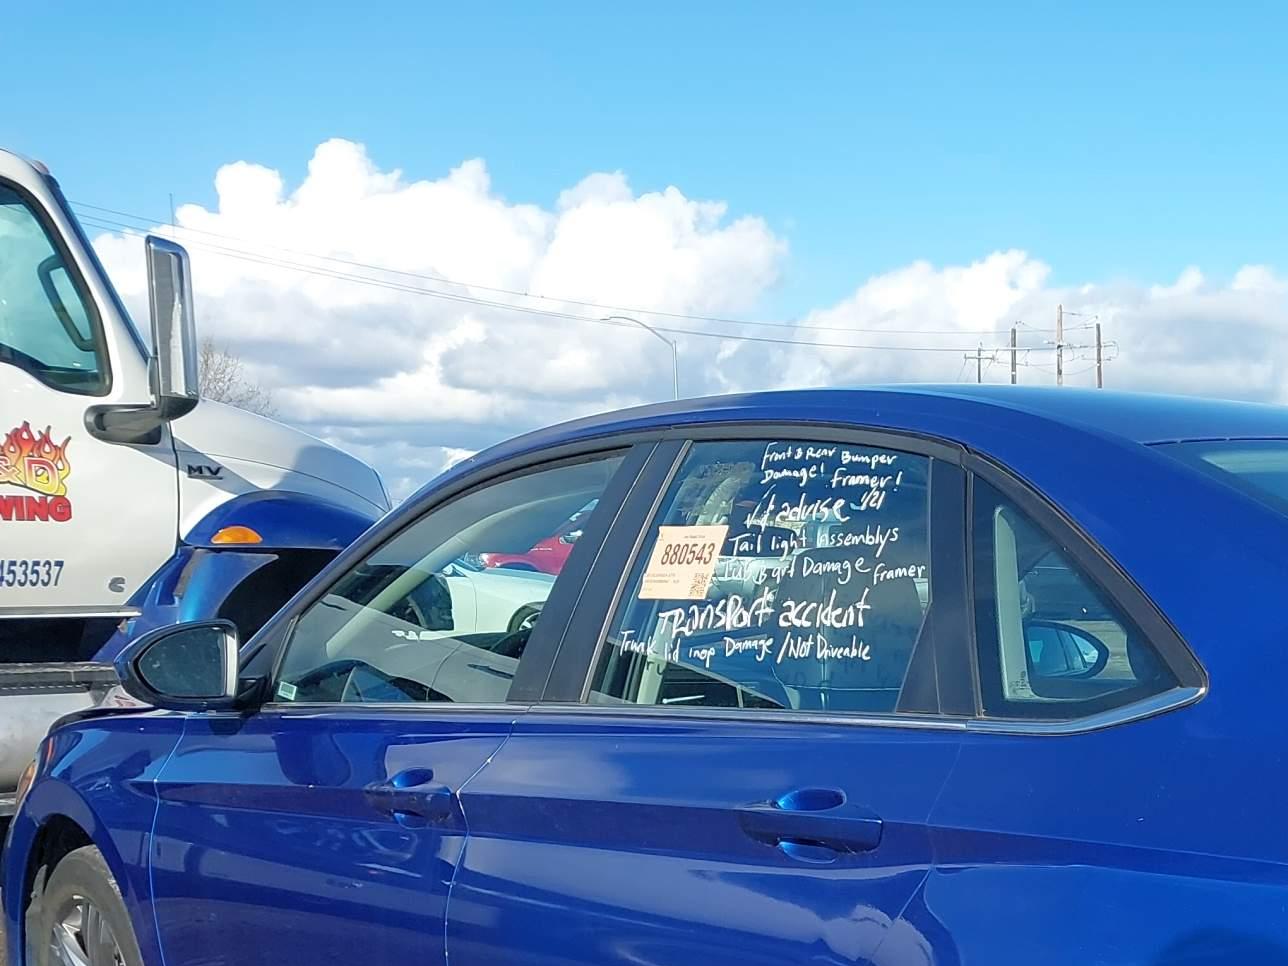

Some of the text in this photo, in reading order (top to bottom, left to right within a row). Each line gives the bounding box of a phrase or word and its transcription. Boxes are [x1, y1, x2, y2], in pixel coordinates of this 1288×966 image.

[188, 465, 221, 476] MV
[761, 442, 792, 470] Front
[806, 446, 837, 460] Rear
[841, 451, 897, 469] Bumper
[661, 543, 715, 565] 880543
[728, 532, 761, 556] Tail
[771, 529, 807, 561] light
[803, 556, 871, 585] Damage
[778, 588, 871, 628] accident
[620, 630, 657, 656] Trunk
[664, 640, 680, 663] lid
[724, 636, 774, 662] Damage
